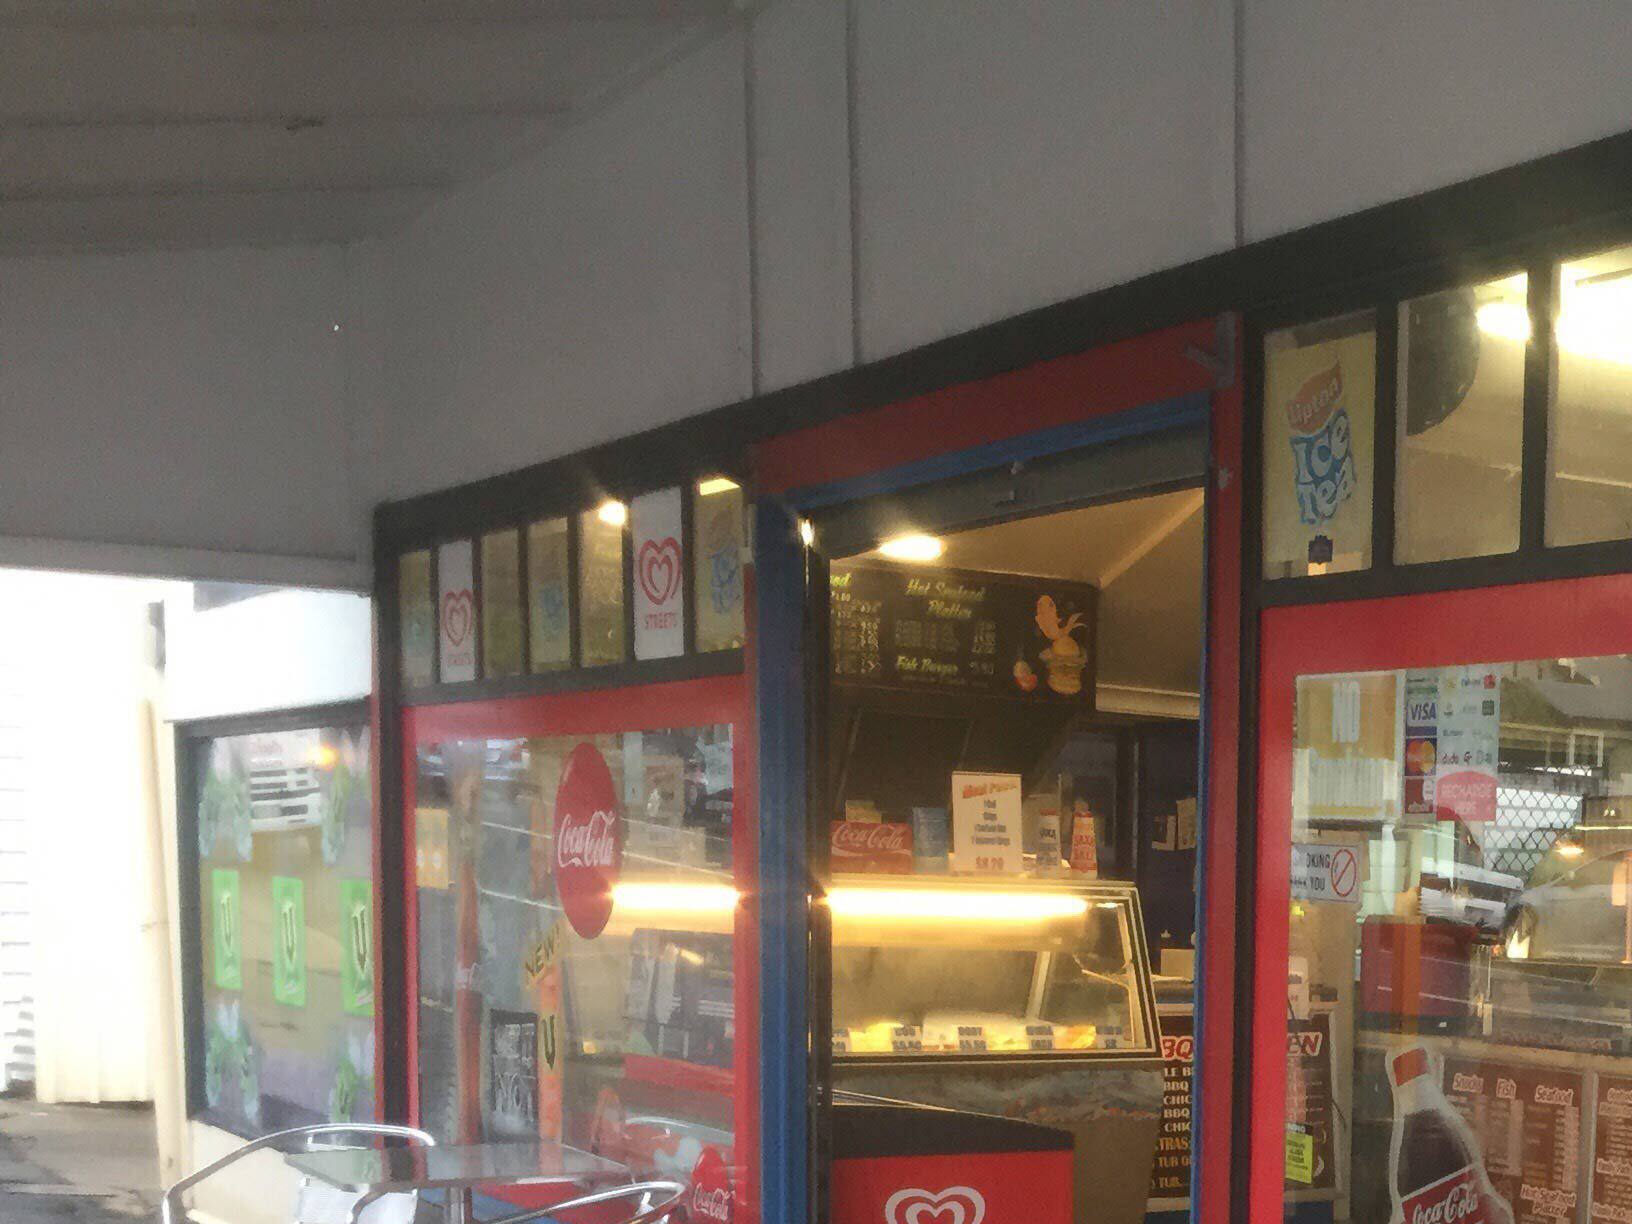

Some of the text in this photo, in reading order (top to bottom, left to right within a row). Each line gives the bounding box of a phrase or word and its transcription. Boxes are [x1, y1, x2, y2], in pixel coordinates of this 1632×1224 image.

[1411, 703, 1437, 721] VISA
[558, 810, 616, 868] Coca-Cola
[832, 823, 905, 850] Coca-Cola
[1309, 877, 1326, 891] YOU
[1163, 1080, 1189, 1092] BBQ
[1497, 1078, 1517, 1099] Fish
[1535, 1085, 1574, 1107] Seafood
[1163, 1108, 1190, 1119] BBQ
[1158, 1156, 1178, 1168] TUB
[1521, 1184, 1577, 1208] Hot Seafood
